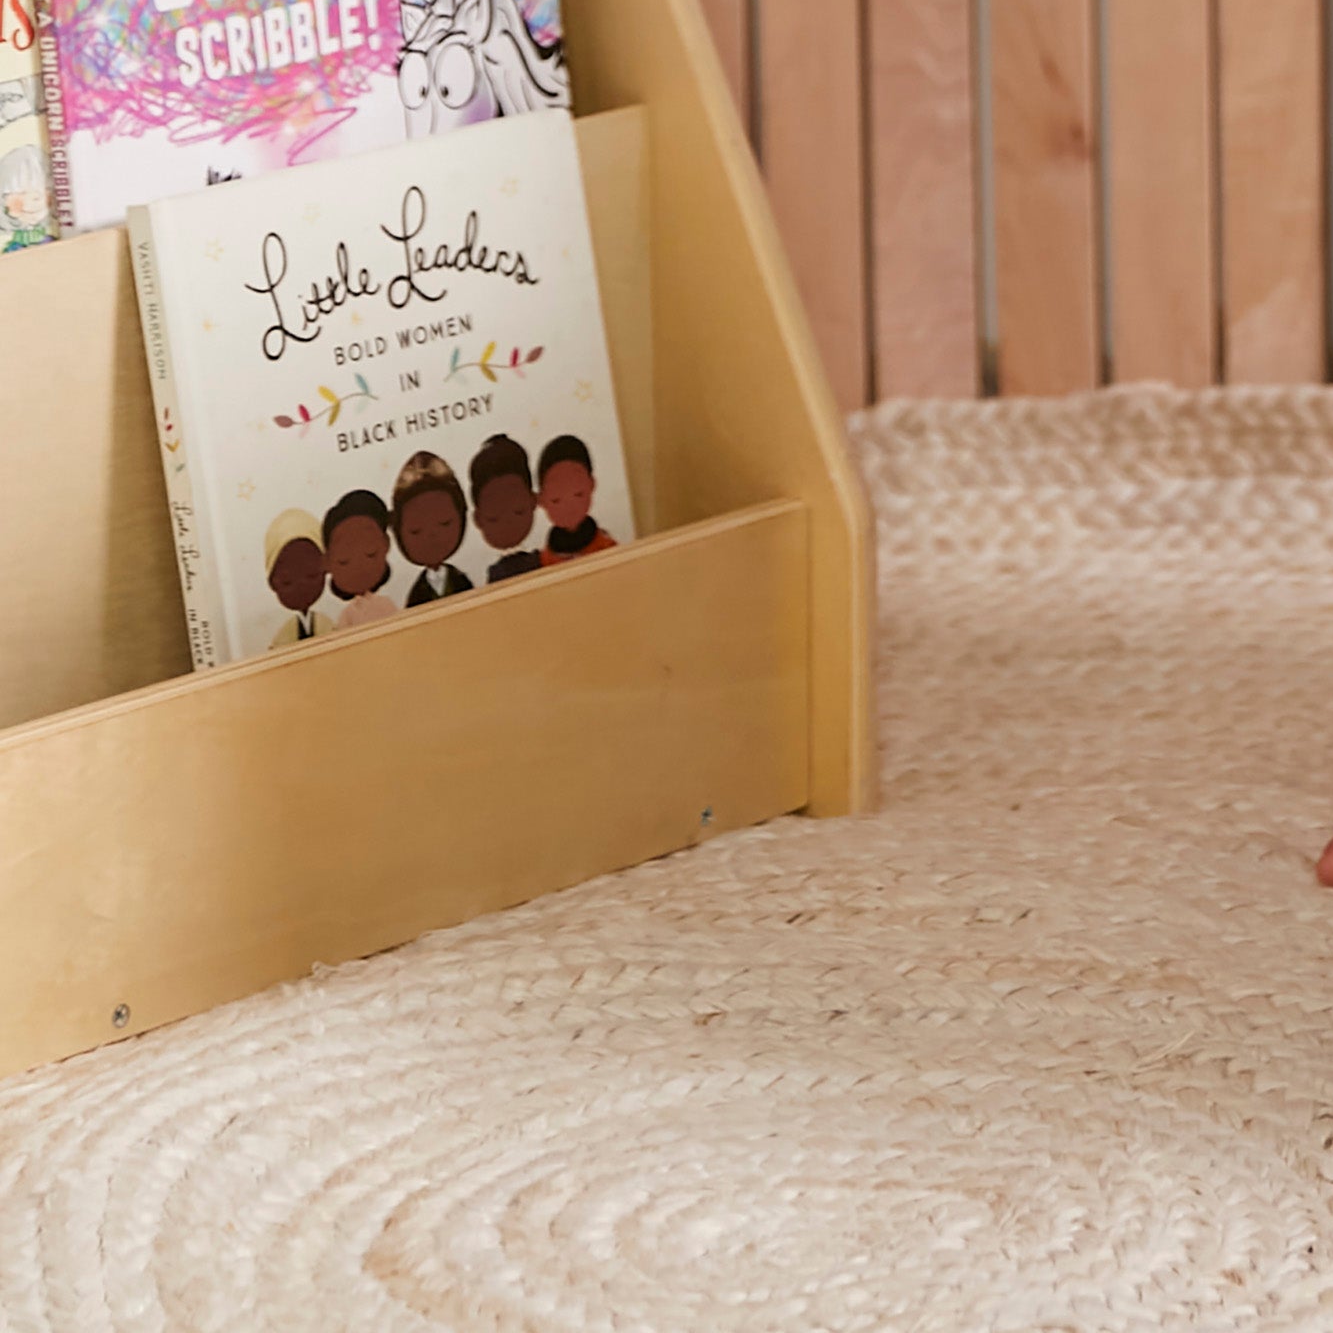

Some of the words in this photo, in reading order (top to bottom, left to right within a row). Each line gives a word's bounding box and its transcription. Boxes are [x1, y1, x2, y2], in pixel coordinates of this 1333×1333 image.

[37, 12, 54, 28] A
[40, 37, 64, 131] UNICORN
[51, 139, 74, 227] SCRIBBLE!
[244, 232, 381, 361] Little
[380, 186, 540, 308] Leaders
[333, 336, 386, 366] BOLD
[397, 314, 474, 348] WOMEN
[399, 371, 421, 391] IN
[337, 420, 397, 453] BLACK
[406, 393, 495, 434] HISTORY
